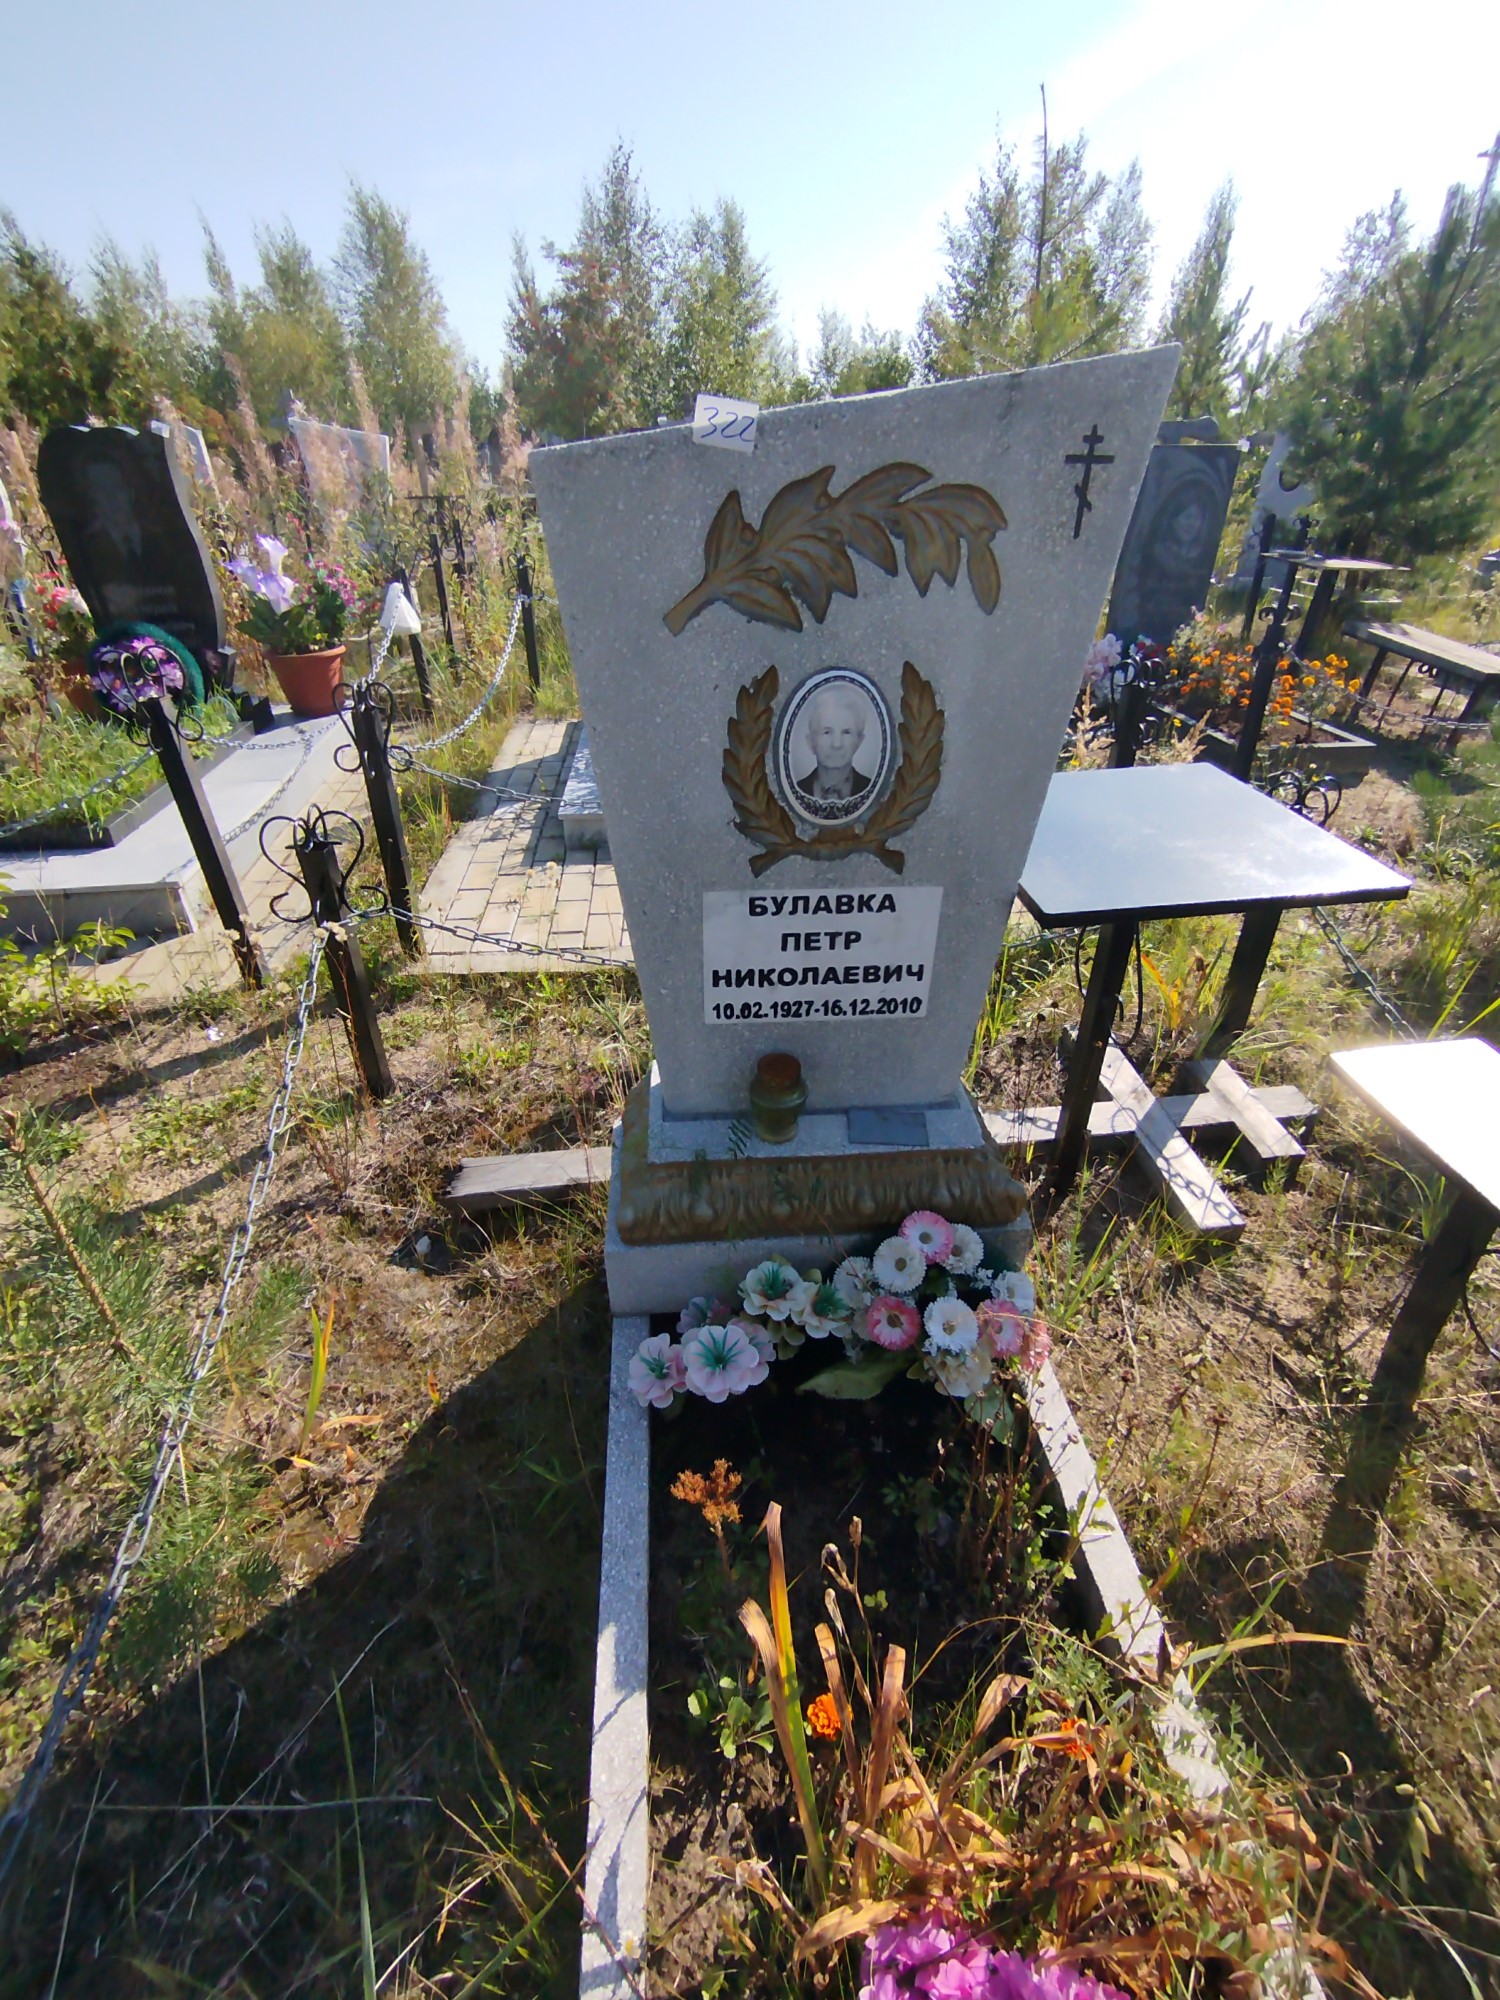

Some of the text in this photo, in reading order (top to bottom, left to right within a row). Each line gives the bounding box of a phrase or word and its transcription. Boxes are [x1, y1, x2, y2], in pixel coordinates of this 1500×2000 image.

[701, 407, 755, 442] 322
[749, 894, 897, 917] БУЛАВКА
[781, 931, 862, 952] ПЕТР
[712, 964, 925, 989] НИКОЛАЕВИЧ
[712, 997, 923, 1020] 10.02.1927-16.12.2010
